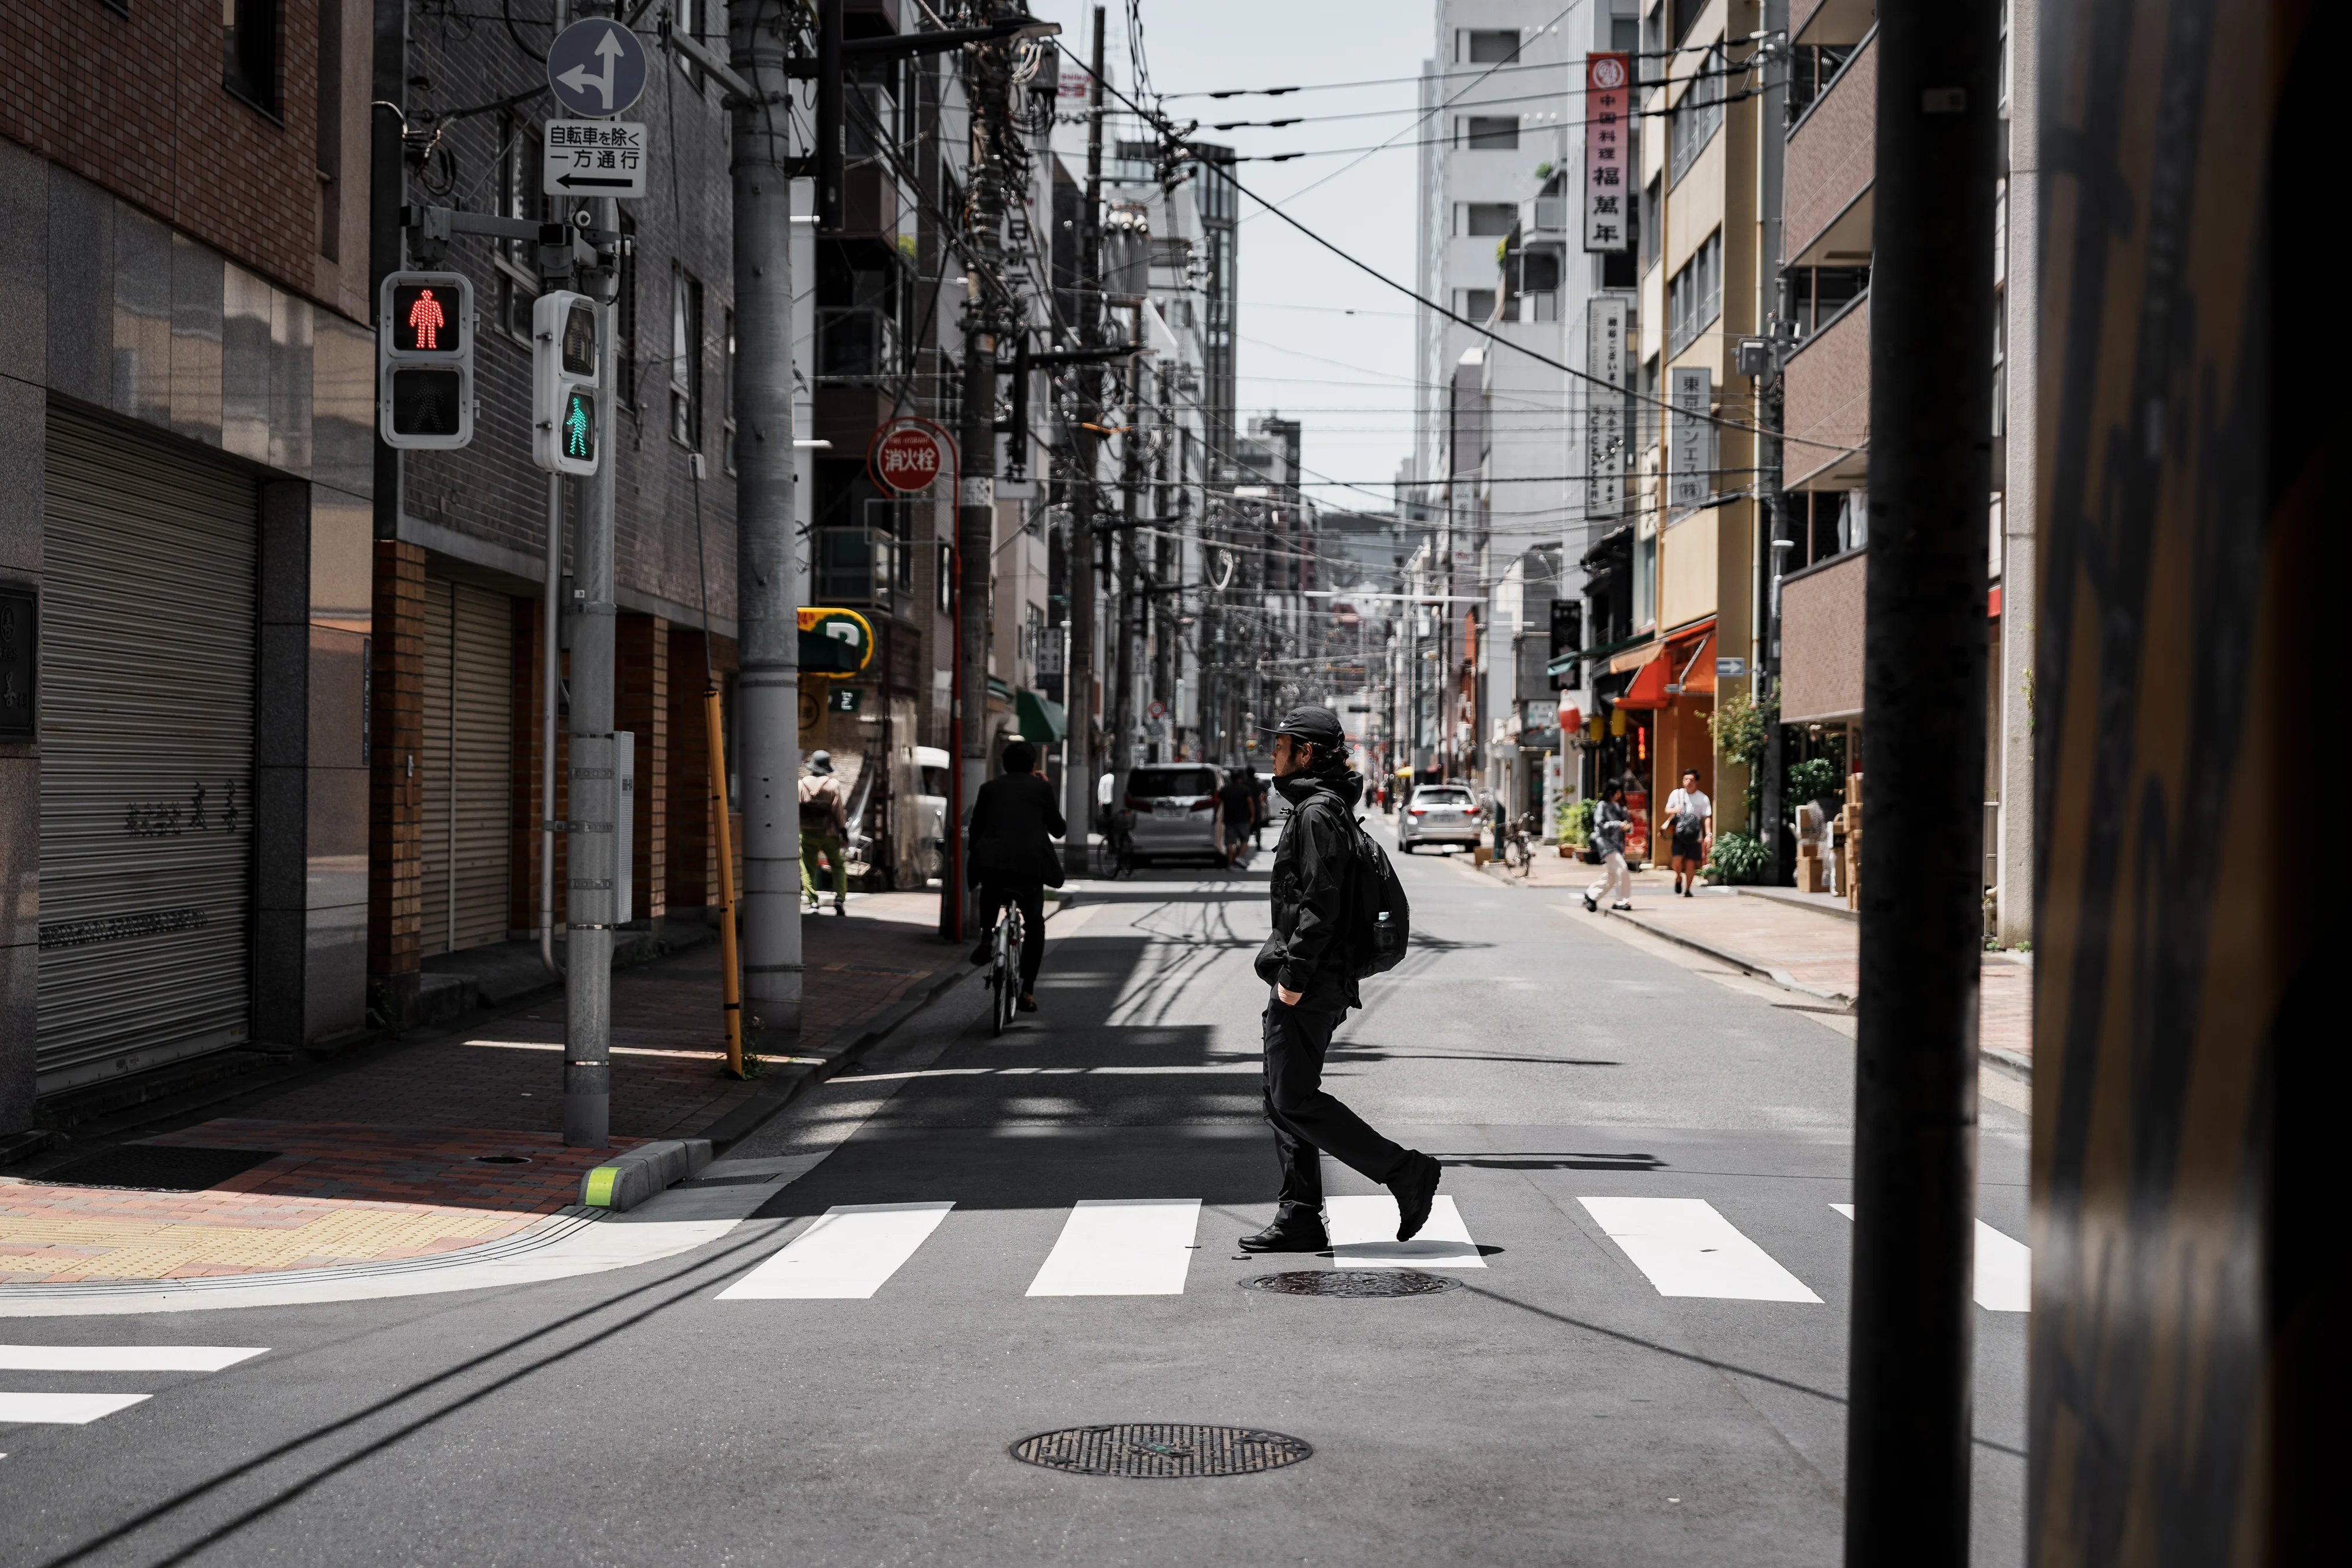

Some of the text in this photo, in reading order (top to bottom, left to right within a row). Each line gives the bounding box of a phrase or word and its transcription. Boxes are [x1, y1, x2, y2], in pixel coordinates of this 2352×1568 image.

[551, 125, 639, 146] 自転車を除く
[550, 149, 639, 169] 一方通行
[884, 447, 936, 472] 消火栓
